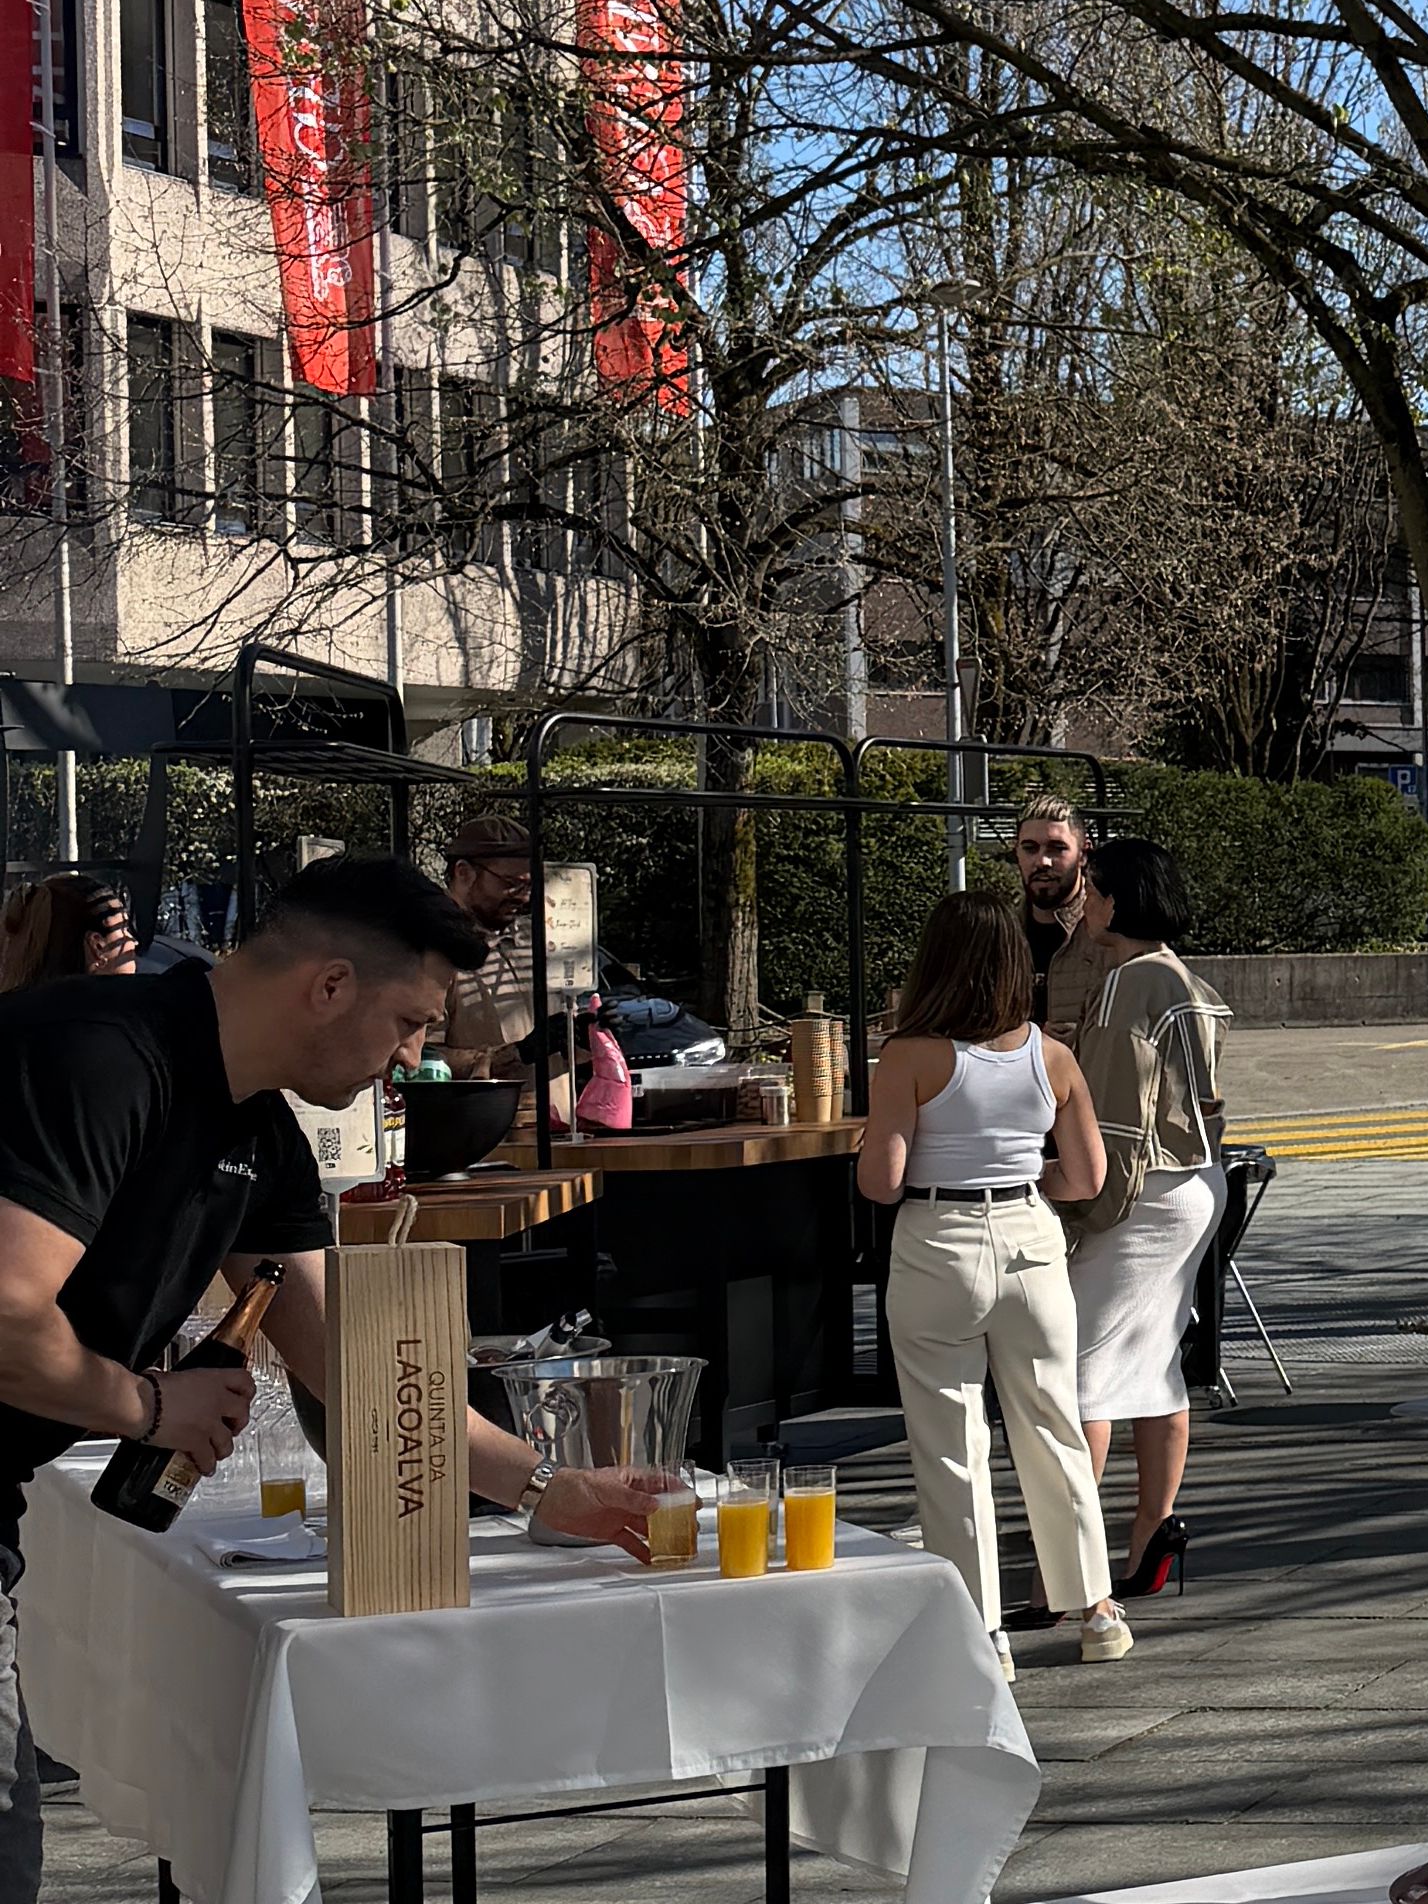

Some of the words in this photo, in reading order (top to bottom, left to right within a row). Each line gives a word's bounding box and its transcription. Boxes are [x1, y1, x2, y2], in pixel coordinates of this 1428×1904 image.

[1397, 770, 1411, 793] P
[396, 1339, 424, 1519] LAGOALVA
[428, 1371, 445, 1448] QUINTA
[430, 1455, 446, 1482] DA
